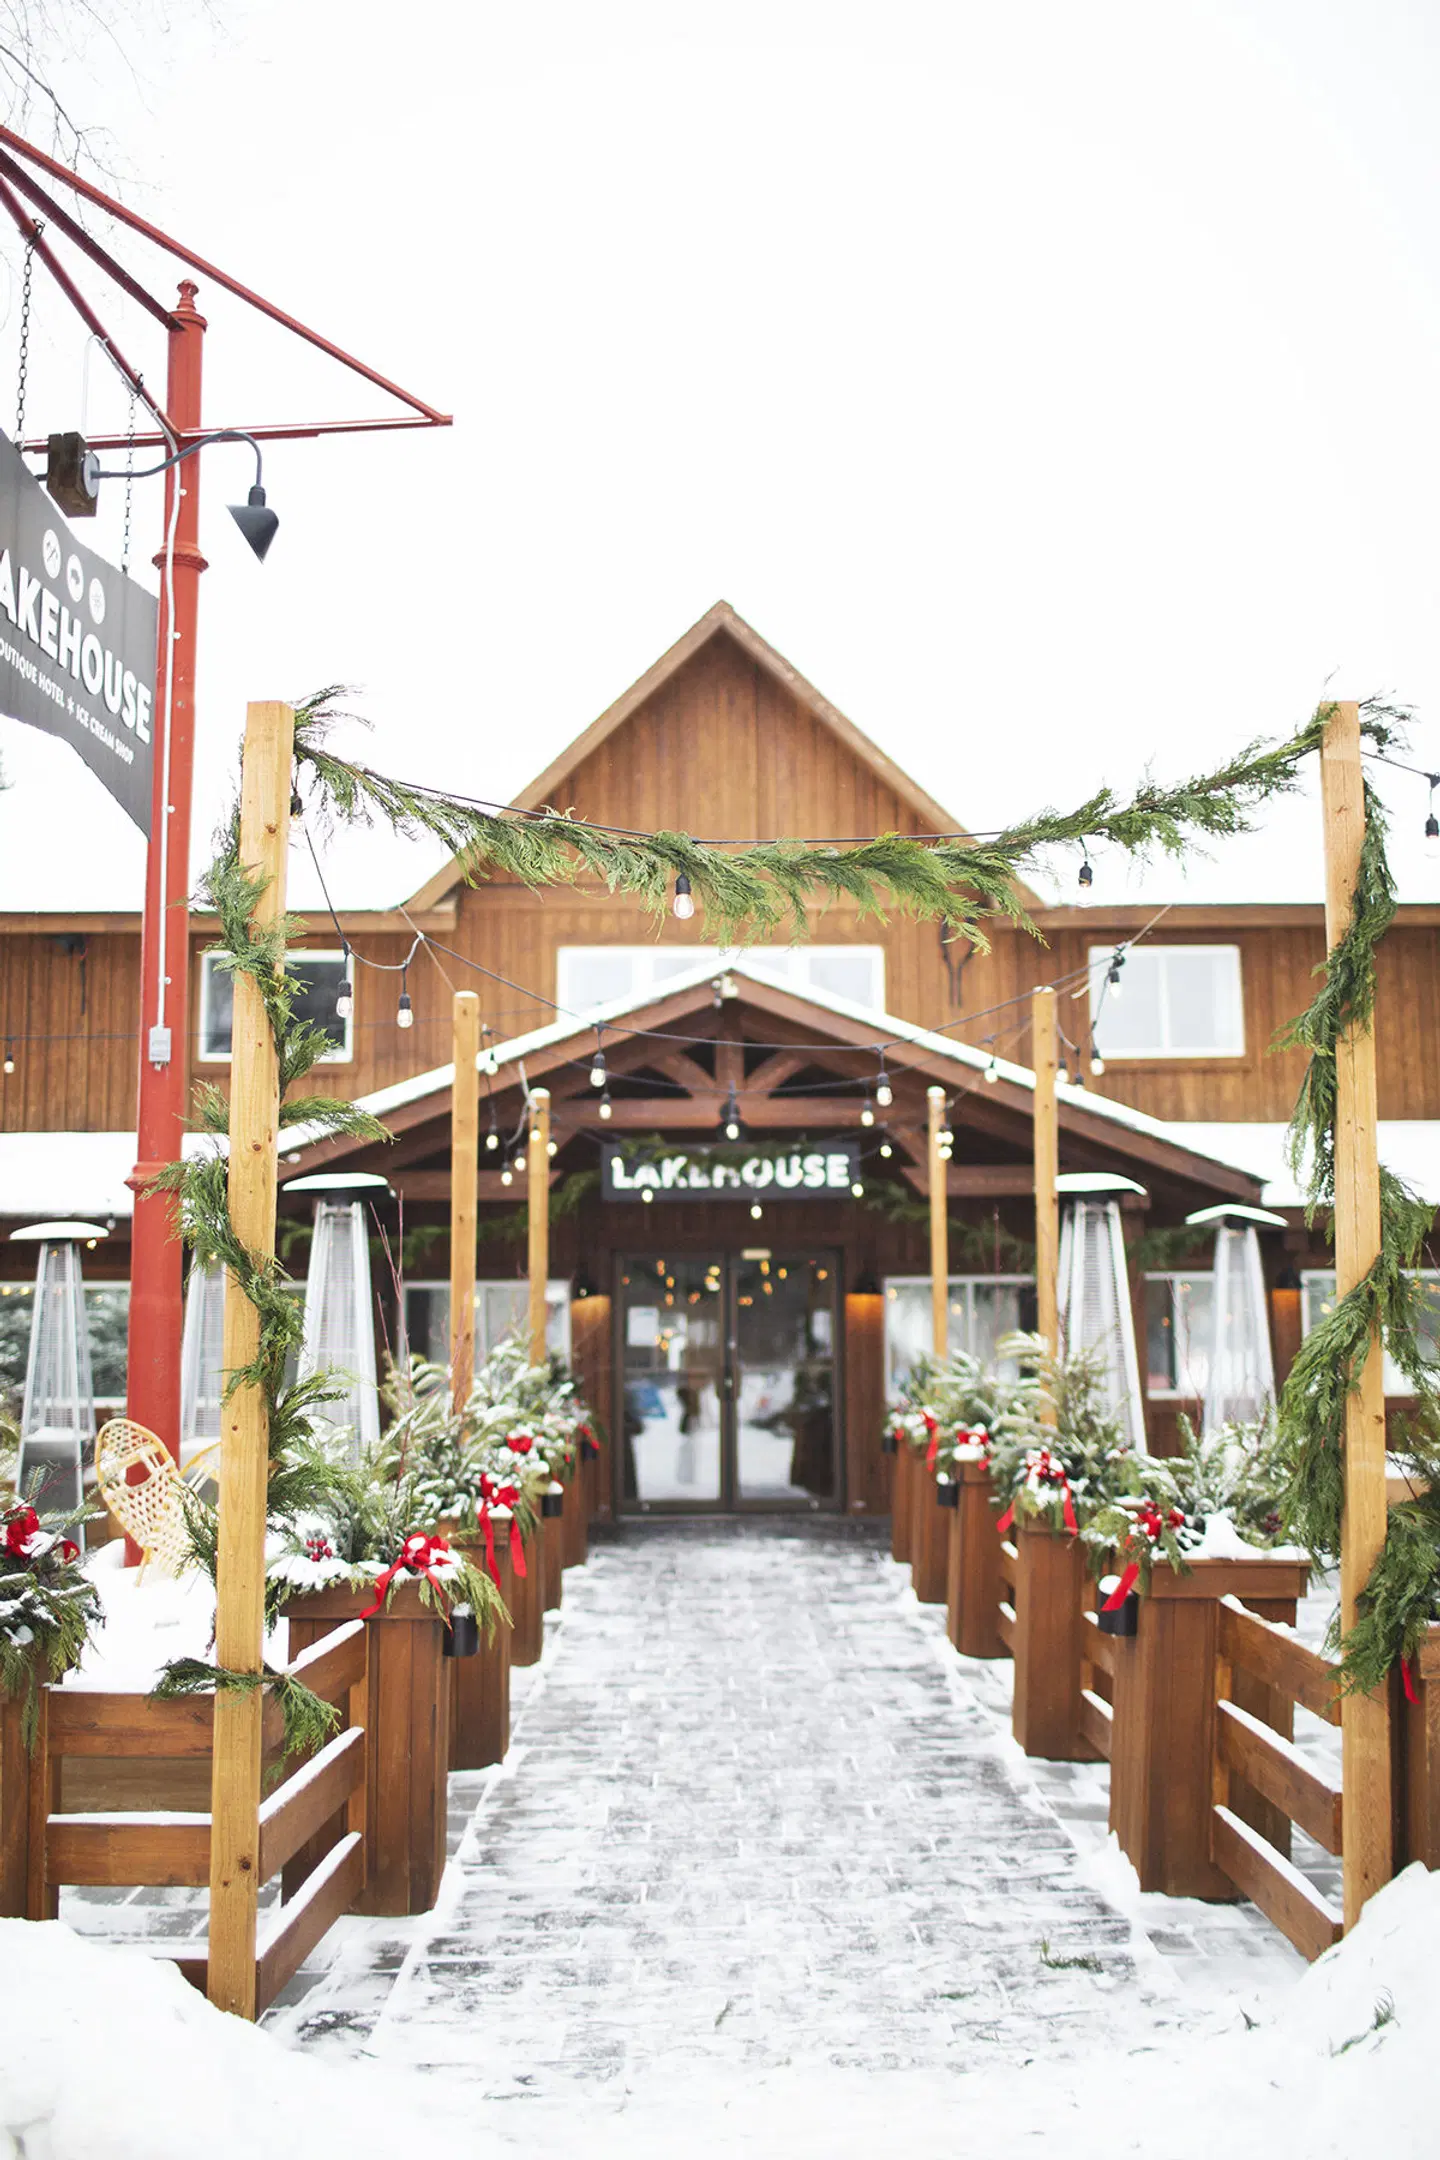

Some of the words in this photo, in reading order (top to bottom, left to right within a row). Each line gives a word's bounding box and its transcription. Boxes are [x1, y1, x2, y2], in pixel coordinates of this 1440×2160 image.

[38, 671, 65, 708] HOTEL
[76, 704, 90, 729] ICE
[89, 716, 115, 750] CREAM
